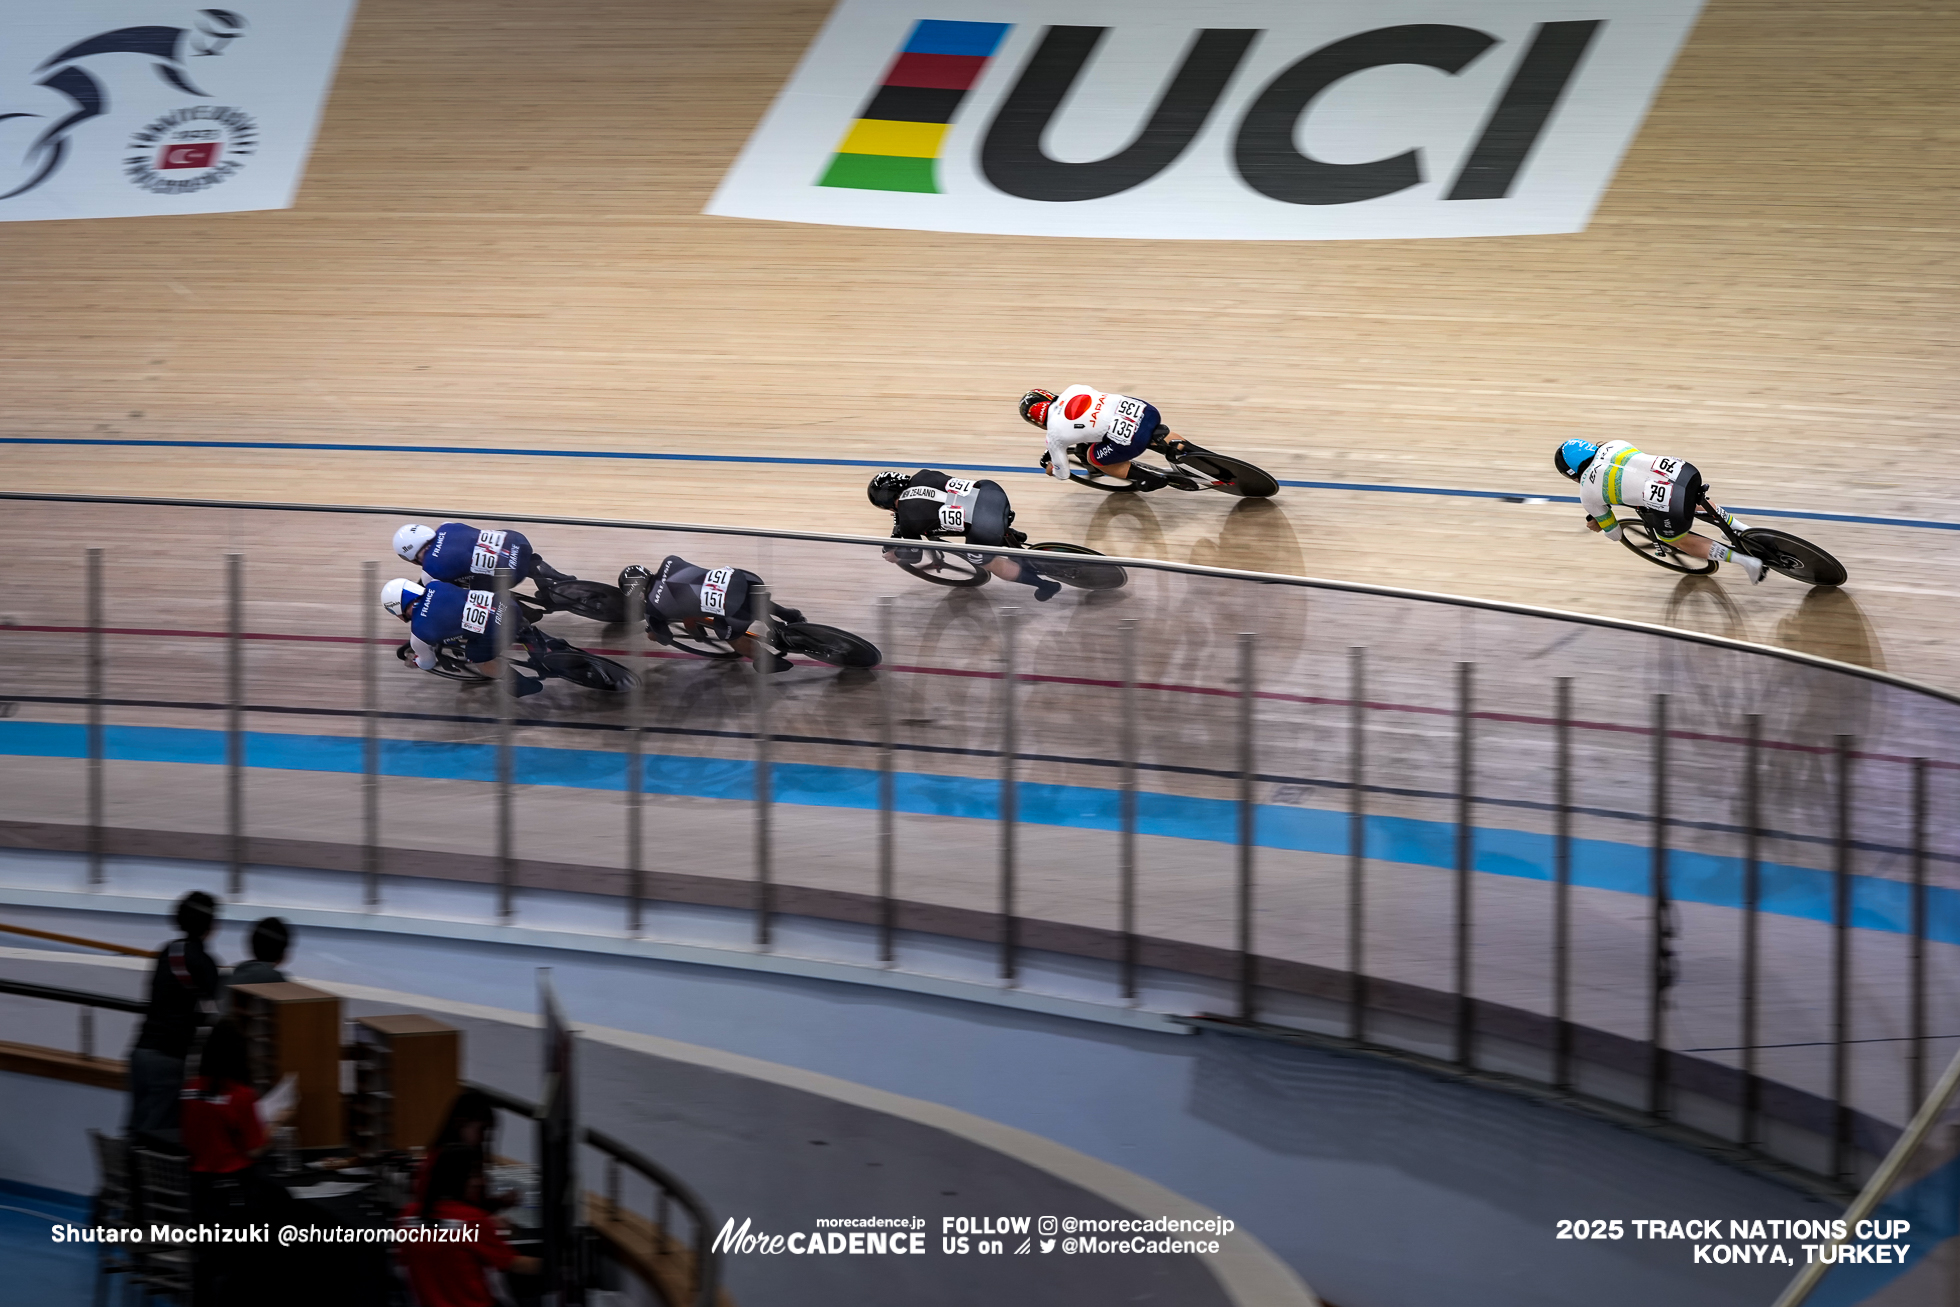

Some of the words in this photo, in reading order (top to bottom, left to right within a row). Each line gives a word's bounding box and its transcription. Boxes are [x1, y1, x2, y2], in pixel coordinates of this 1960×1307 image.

[976, 18, 1609, 206] UCI
[1118, 400, 1141, 419] 135
[1112, 418, 1134, 439] 135
[1659, 458, 1677, 474] 79
[902, 488, 910, 498] NEW
[910, 488, 936, 498] ZEALAND
[948, 480, 971, 492] 158
[1649, 484, 1666, 503] 79
[941, 510, 962, 526] 158
[432, 531, 447, 558] FRANCE
[480, 532, 500, 547] 110
[475, 552, 495, 569] 110
[508, 544, 520, 570] FRANCE
[654, 560, 673, 604] MALAYSIA
[707, 570, 727, 585] 151
[420, 588, 436, 618] FRANCE
[469, 592, 490, 607] 106
[704, 591, 723, 608] 151
[466, 607, 487, 626] 106
